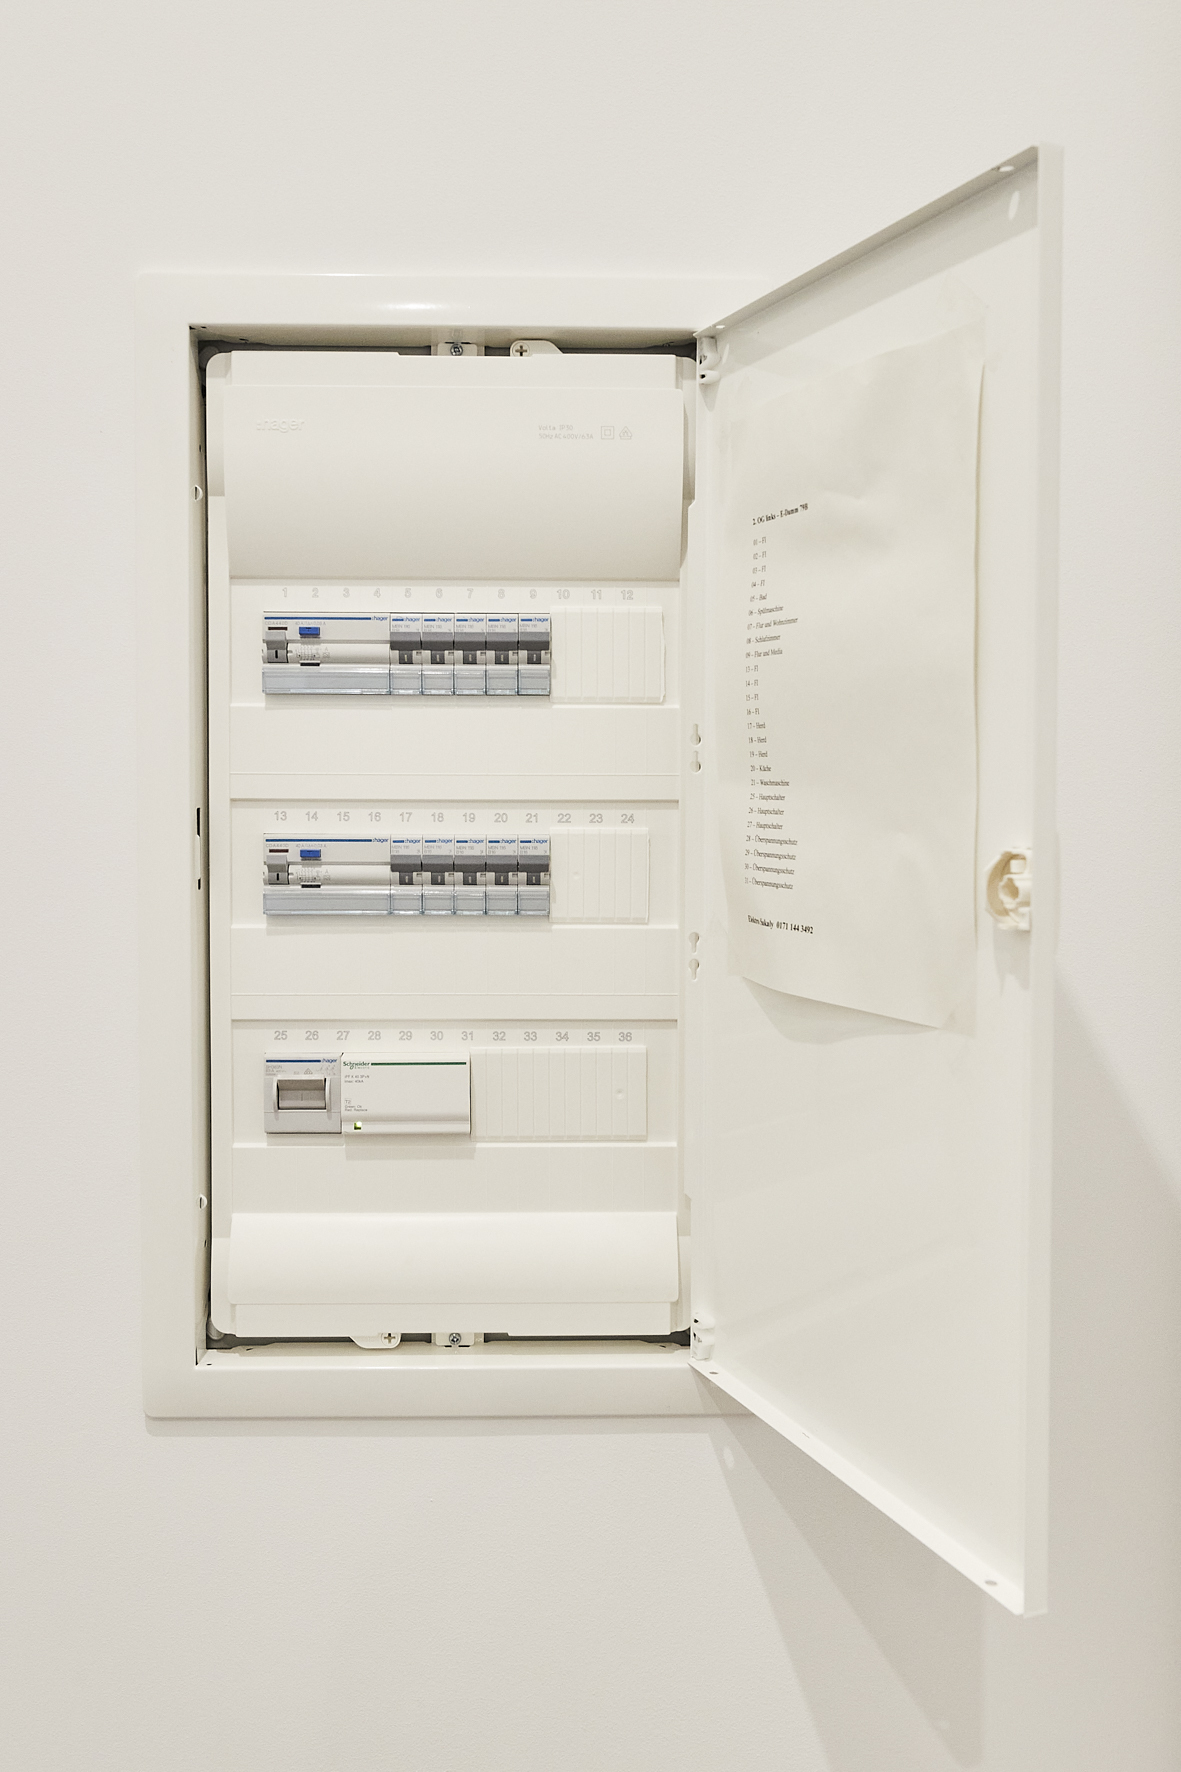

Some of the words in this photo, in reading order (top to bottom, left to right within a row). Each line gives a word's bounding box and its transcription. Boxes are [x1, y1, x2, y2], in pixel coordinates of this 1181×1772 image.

[757, 516, 765, 524] OG
[766, 513, 776, 522] links
[281, 587, 287, 598] 1
[312, 588, 319, 598] 2
[343, 588, 350, 598] 3
[374, 588, 381, 598] 4
[405, 588, 411, 598] 5
[436, 588, 443, 598] 6
[467, 588, 474, 598] 7
[498, 589, 505, 599] 8
[530, 589, 537, 599] 9
[557, 589, 570, 600] 10
[590, 589, 602, 600] 11
[621, 590, 634, 600] 12
[759, 793, 785, 802] Hauptschalter
[274, 811, 287, 821] 13
[305, 811, 318, 821] 14
[337, 812, 350, 821] 15
[368, 812, 381, 822] 16
[399, 812, 412, 822] 17
[431, 812, 444, 822] 18
[462, 812, 476, 822] 19
[494, 813, 508, 823] 20
[525, 813, 538, 823] 21
[557, 813, 571, 823] 22
[589, 813, 603, 823] 23
[621, 813, 635, 823] 24
[758, 807, 784, 816] Hauptschalter
[756, 822, 783, 830] Hauptschalter
[755, 835, 798, 846] Überspannungsschutz
[754, 849, 796, 860] Überspannungsschutz
[753, 863, 795, 875] Überspannungsschutz
[752, 877, 793, 889] Überspannungsschutz
[776, 921, 788, 930] 0171
[801, 925, 813, 934] 3492
[274, 1031, 288, 1040] 25
[305, 1031, 319, 1040] 26
[336, 1031, 350, 1041] 27
[368, 1031, 381, 1041] 28
[399, 1031, 412, 1041] 29
[430, 1031, 443, 1041] 30
[461, 1031, 474, 1041] 31
[492, 1031, 506, 1041] 32
[524, 1031, 537, 1041] 33
[556, 1032, 569, 1041] 34
[587, 1032, 601, 1041] 35
[618, 1032, 632, 1042] 36
[343, 1061, 370, 1070] Schneider
